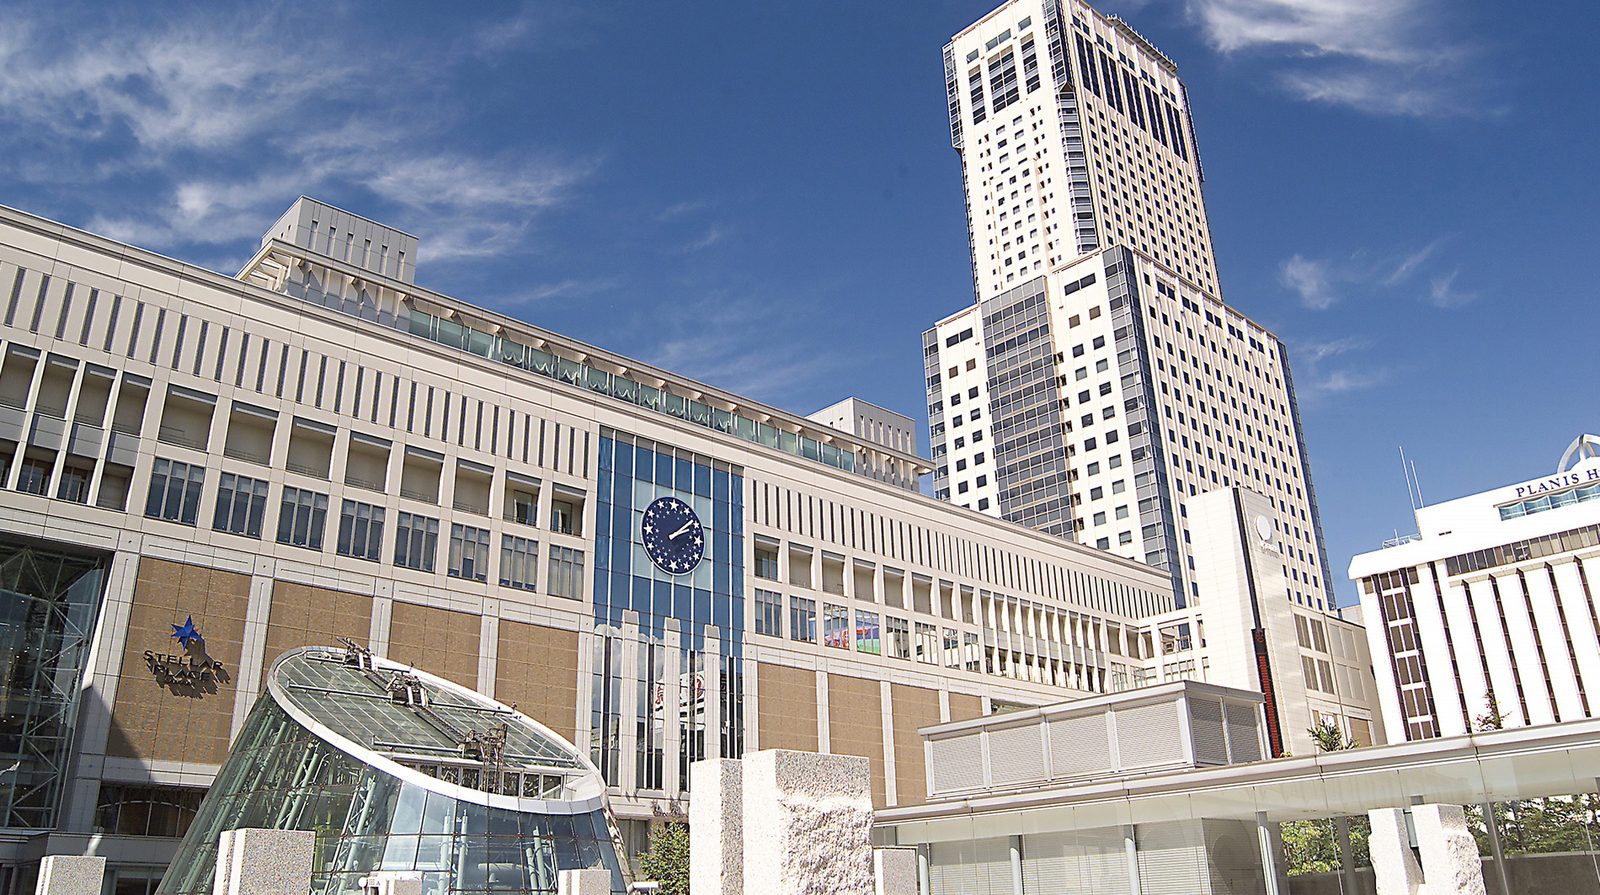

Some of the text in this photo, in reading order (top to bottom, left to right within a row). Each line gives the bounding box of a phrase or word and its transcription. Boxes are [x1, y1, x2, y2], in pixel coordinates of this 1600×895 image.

[1515, 468, 1600, 497] PLANIS H
[143, 650, 224, 670] STELLAR
[152, 664, 211, 681] PLACE
